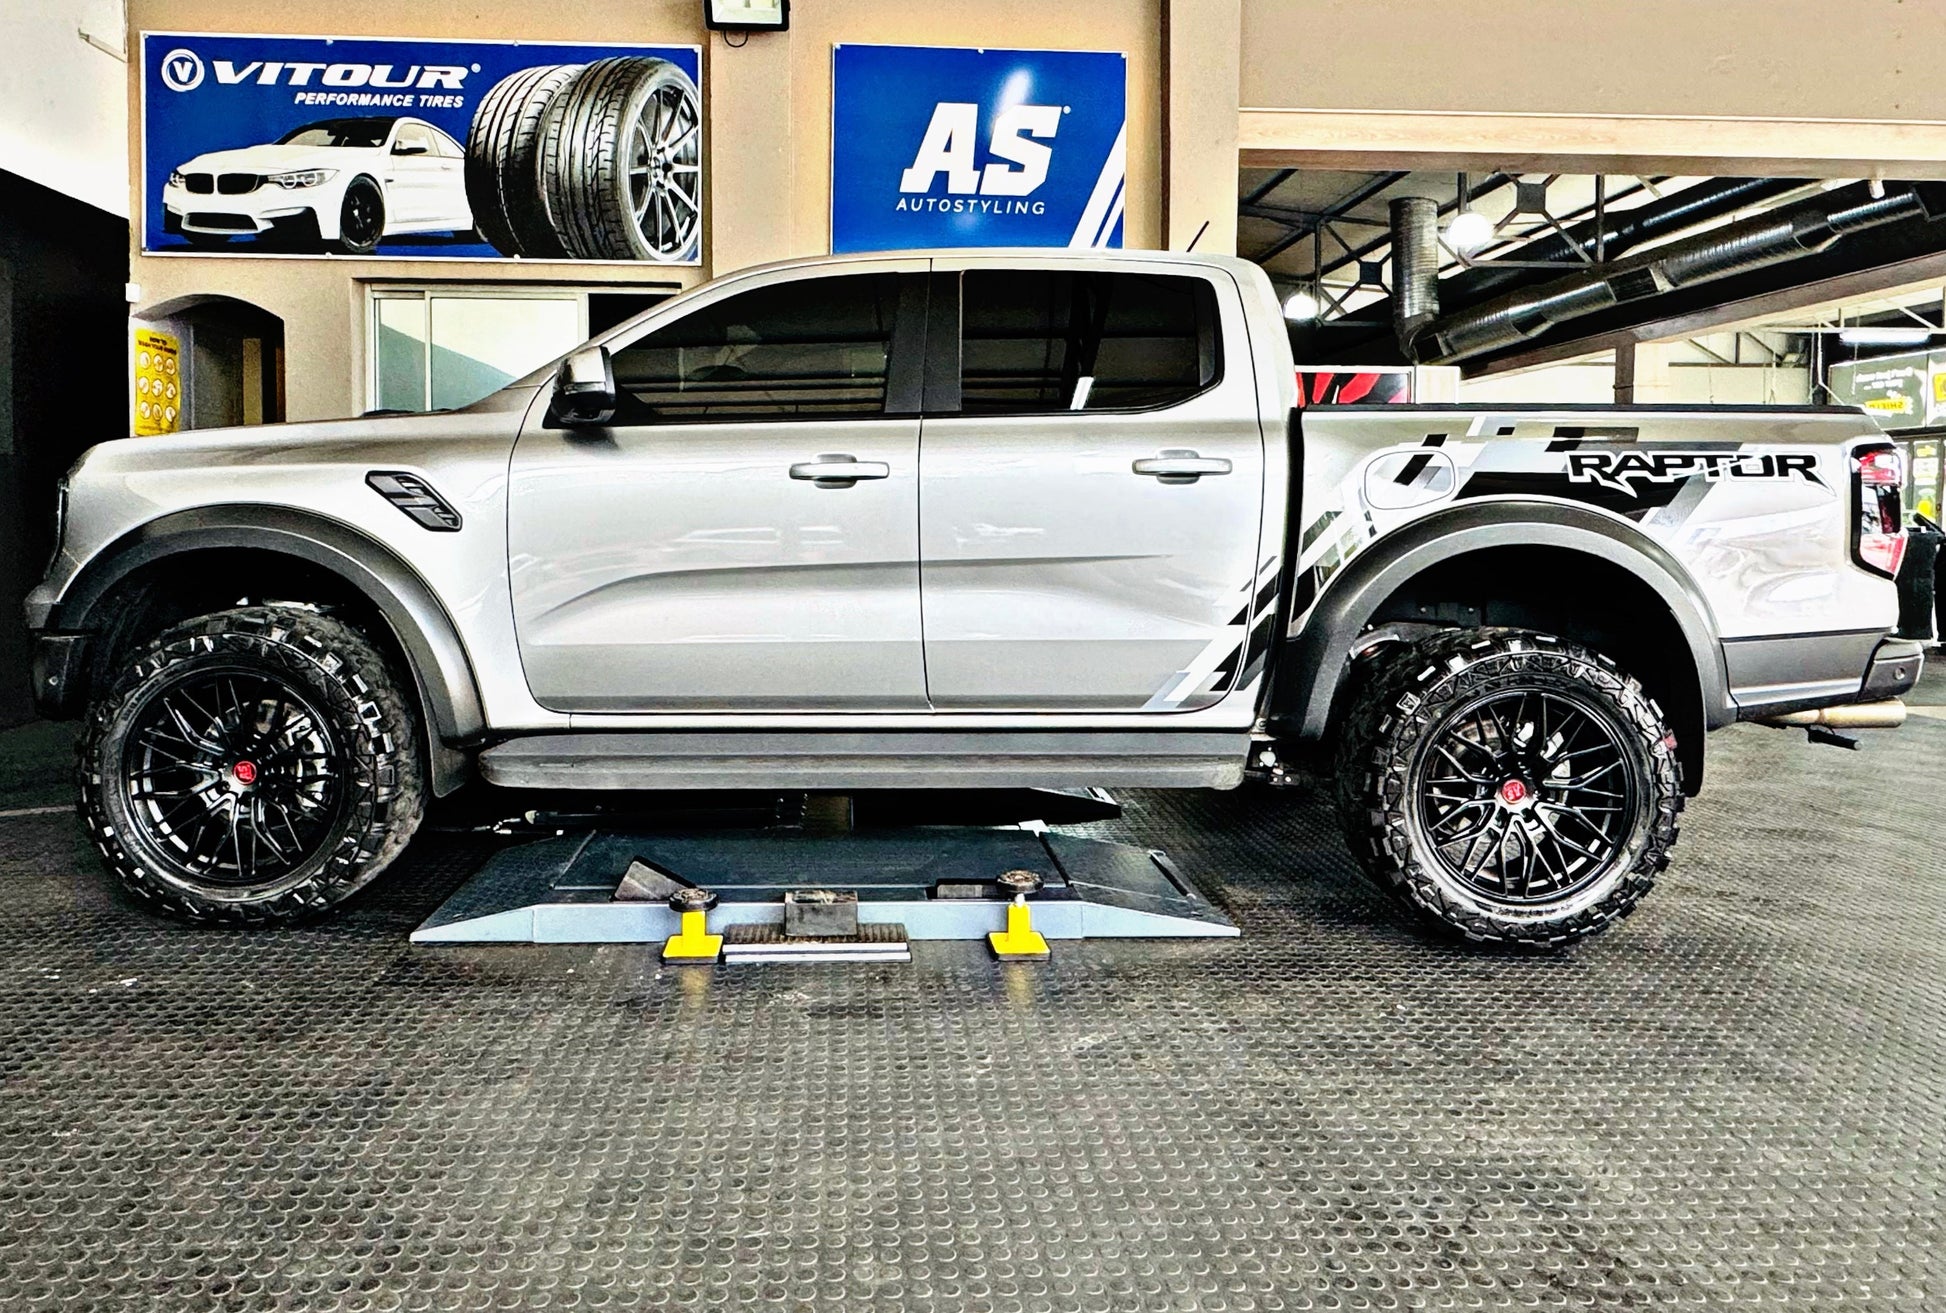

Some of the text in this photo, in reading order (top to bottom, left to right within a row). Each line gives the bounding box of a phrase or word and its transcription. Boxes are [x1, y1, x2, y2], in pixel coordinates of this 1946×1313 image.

[294, 92, 464, 109] PERFORMANCE TIRES
[896, 197, 1046, 216] AUTOSTYLING
[1565, 451, 1837, 498] RAPTOR
